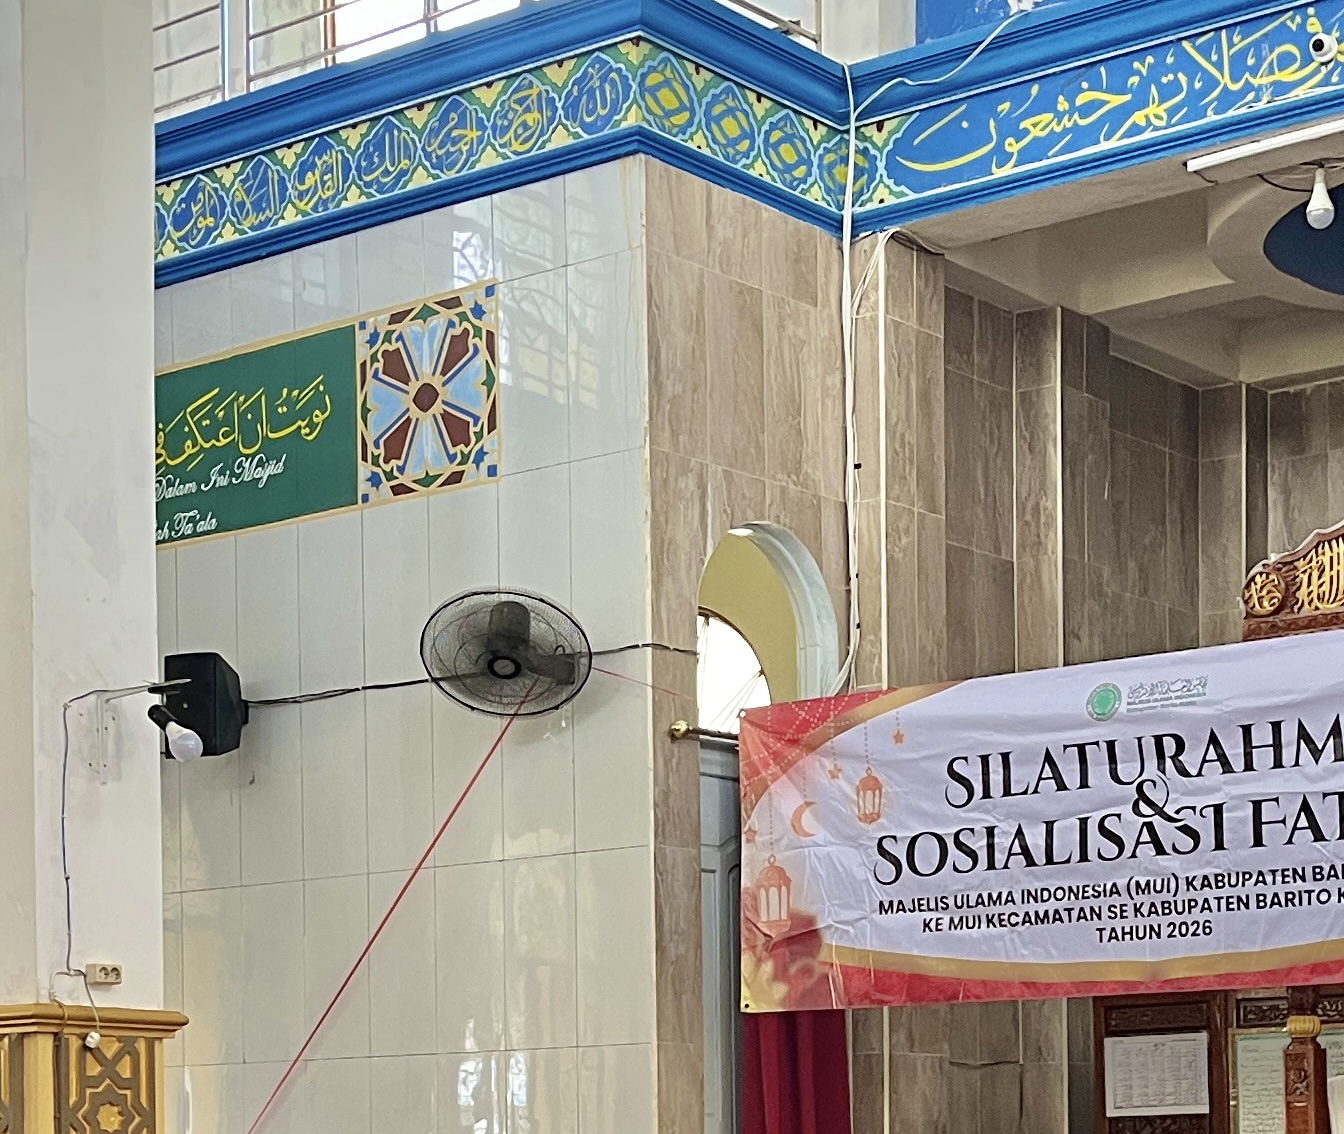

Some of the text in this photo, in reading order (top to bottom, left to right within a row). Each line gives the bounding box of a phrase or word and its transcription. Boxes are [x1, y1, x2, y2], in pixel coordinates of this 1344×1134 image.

[200, 462, 230, 492] Ini
[1131, 773, 1186, 824] &
[873, 802, 1229, 886] SOSIALISASI
[878, 895, 950, 916] MAJELIS
[955, 889, 1015, 911] ULAMA
[1020, 881, 1122, 905] INDONESIA
[1126, 871, 1180, 901] (MUI)
[1185, 865, 1307, 893] KABUPATEN
[922, 916, 944, 933] KE
[948, 914, 982, 931] MUI
[986, 904, 1103, 929] KECAMATAN
[1107, 902, 1129, 920] SE
[1133, 893, 1251, 919] KABUPATEN
[1255, 888, 1333, 911] BARITO
[1096, 919, 1214, 944] TAHUN 2026
